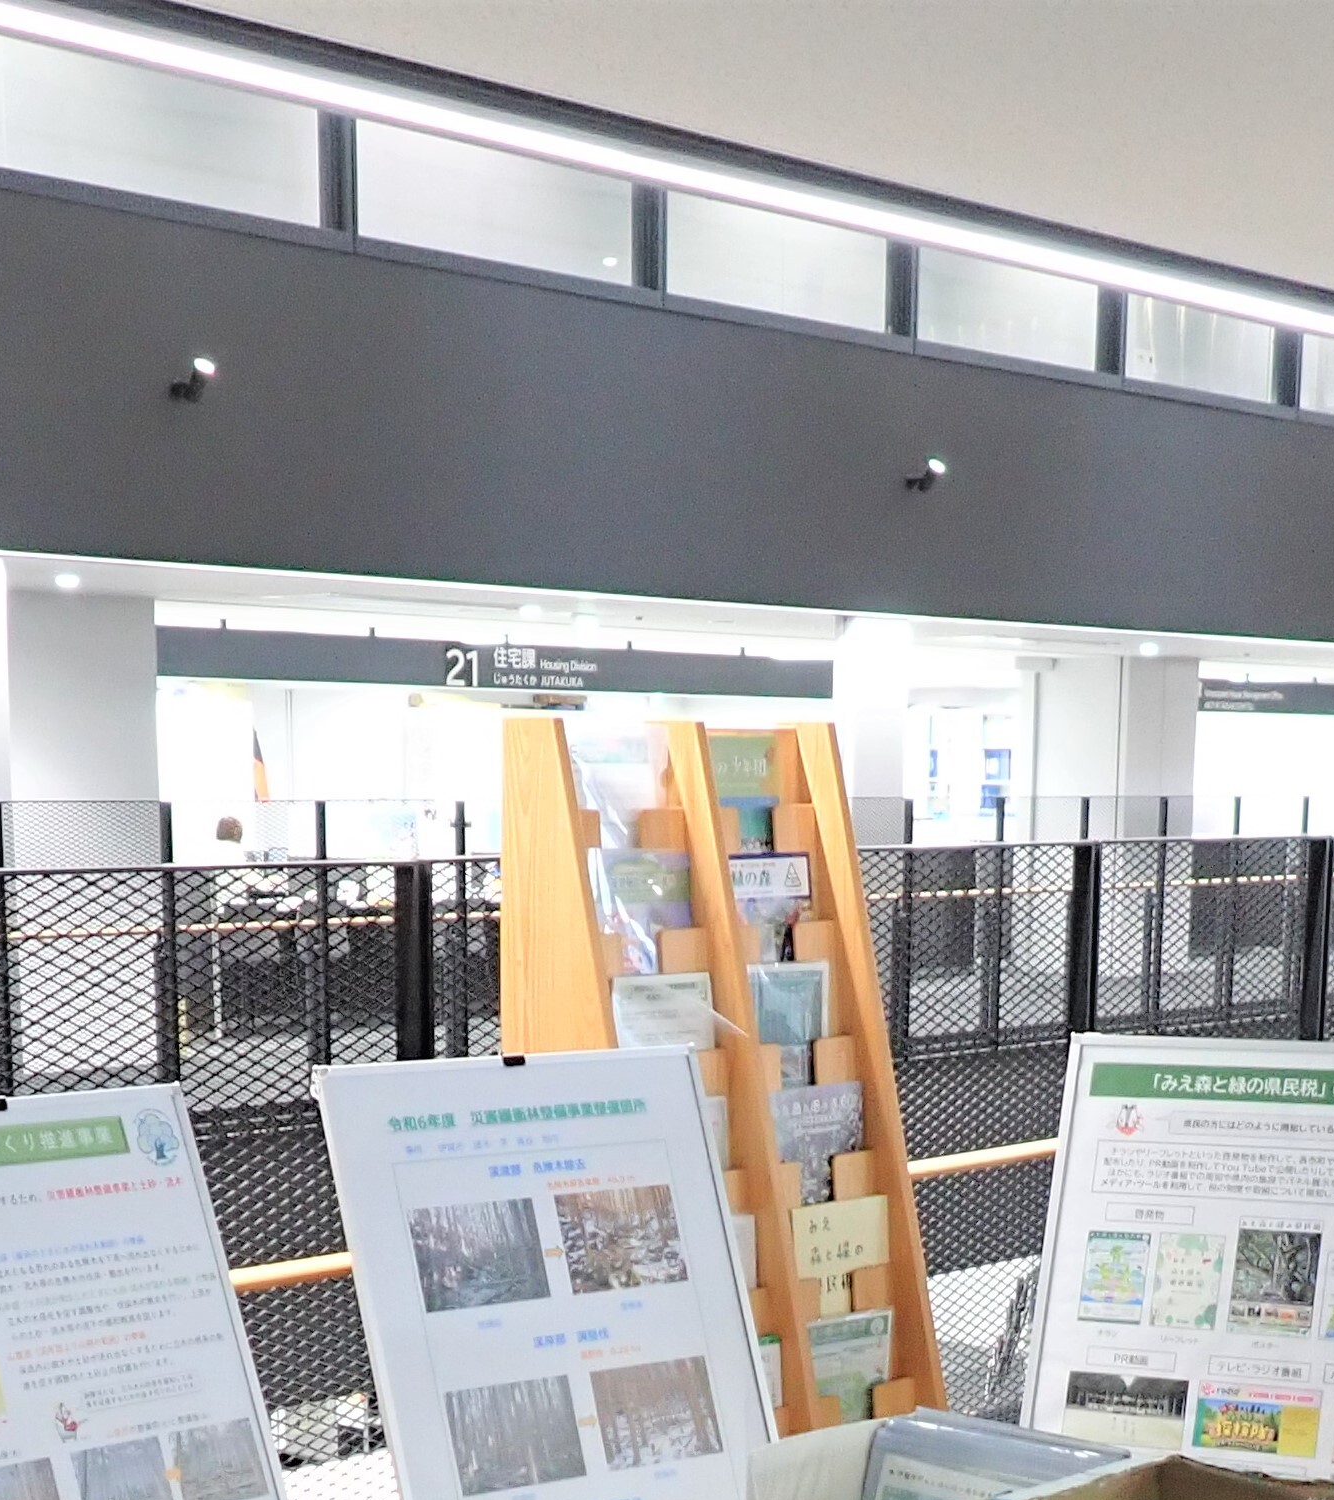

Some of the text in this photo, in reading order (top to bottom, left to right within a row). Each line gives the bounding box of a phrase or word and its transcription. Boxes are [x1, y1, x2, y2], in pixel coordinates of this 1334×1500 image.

[446, 648, 479, 687] 21
[493, 647, 536, 669] 住宅課
[540, 659, 569, 672] Housing
[540, 675, 583, 687] JUTAKUKA
[386, 1112, 456, 1132] 令和6年度
